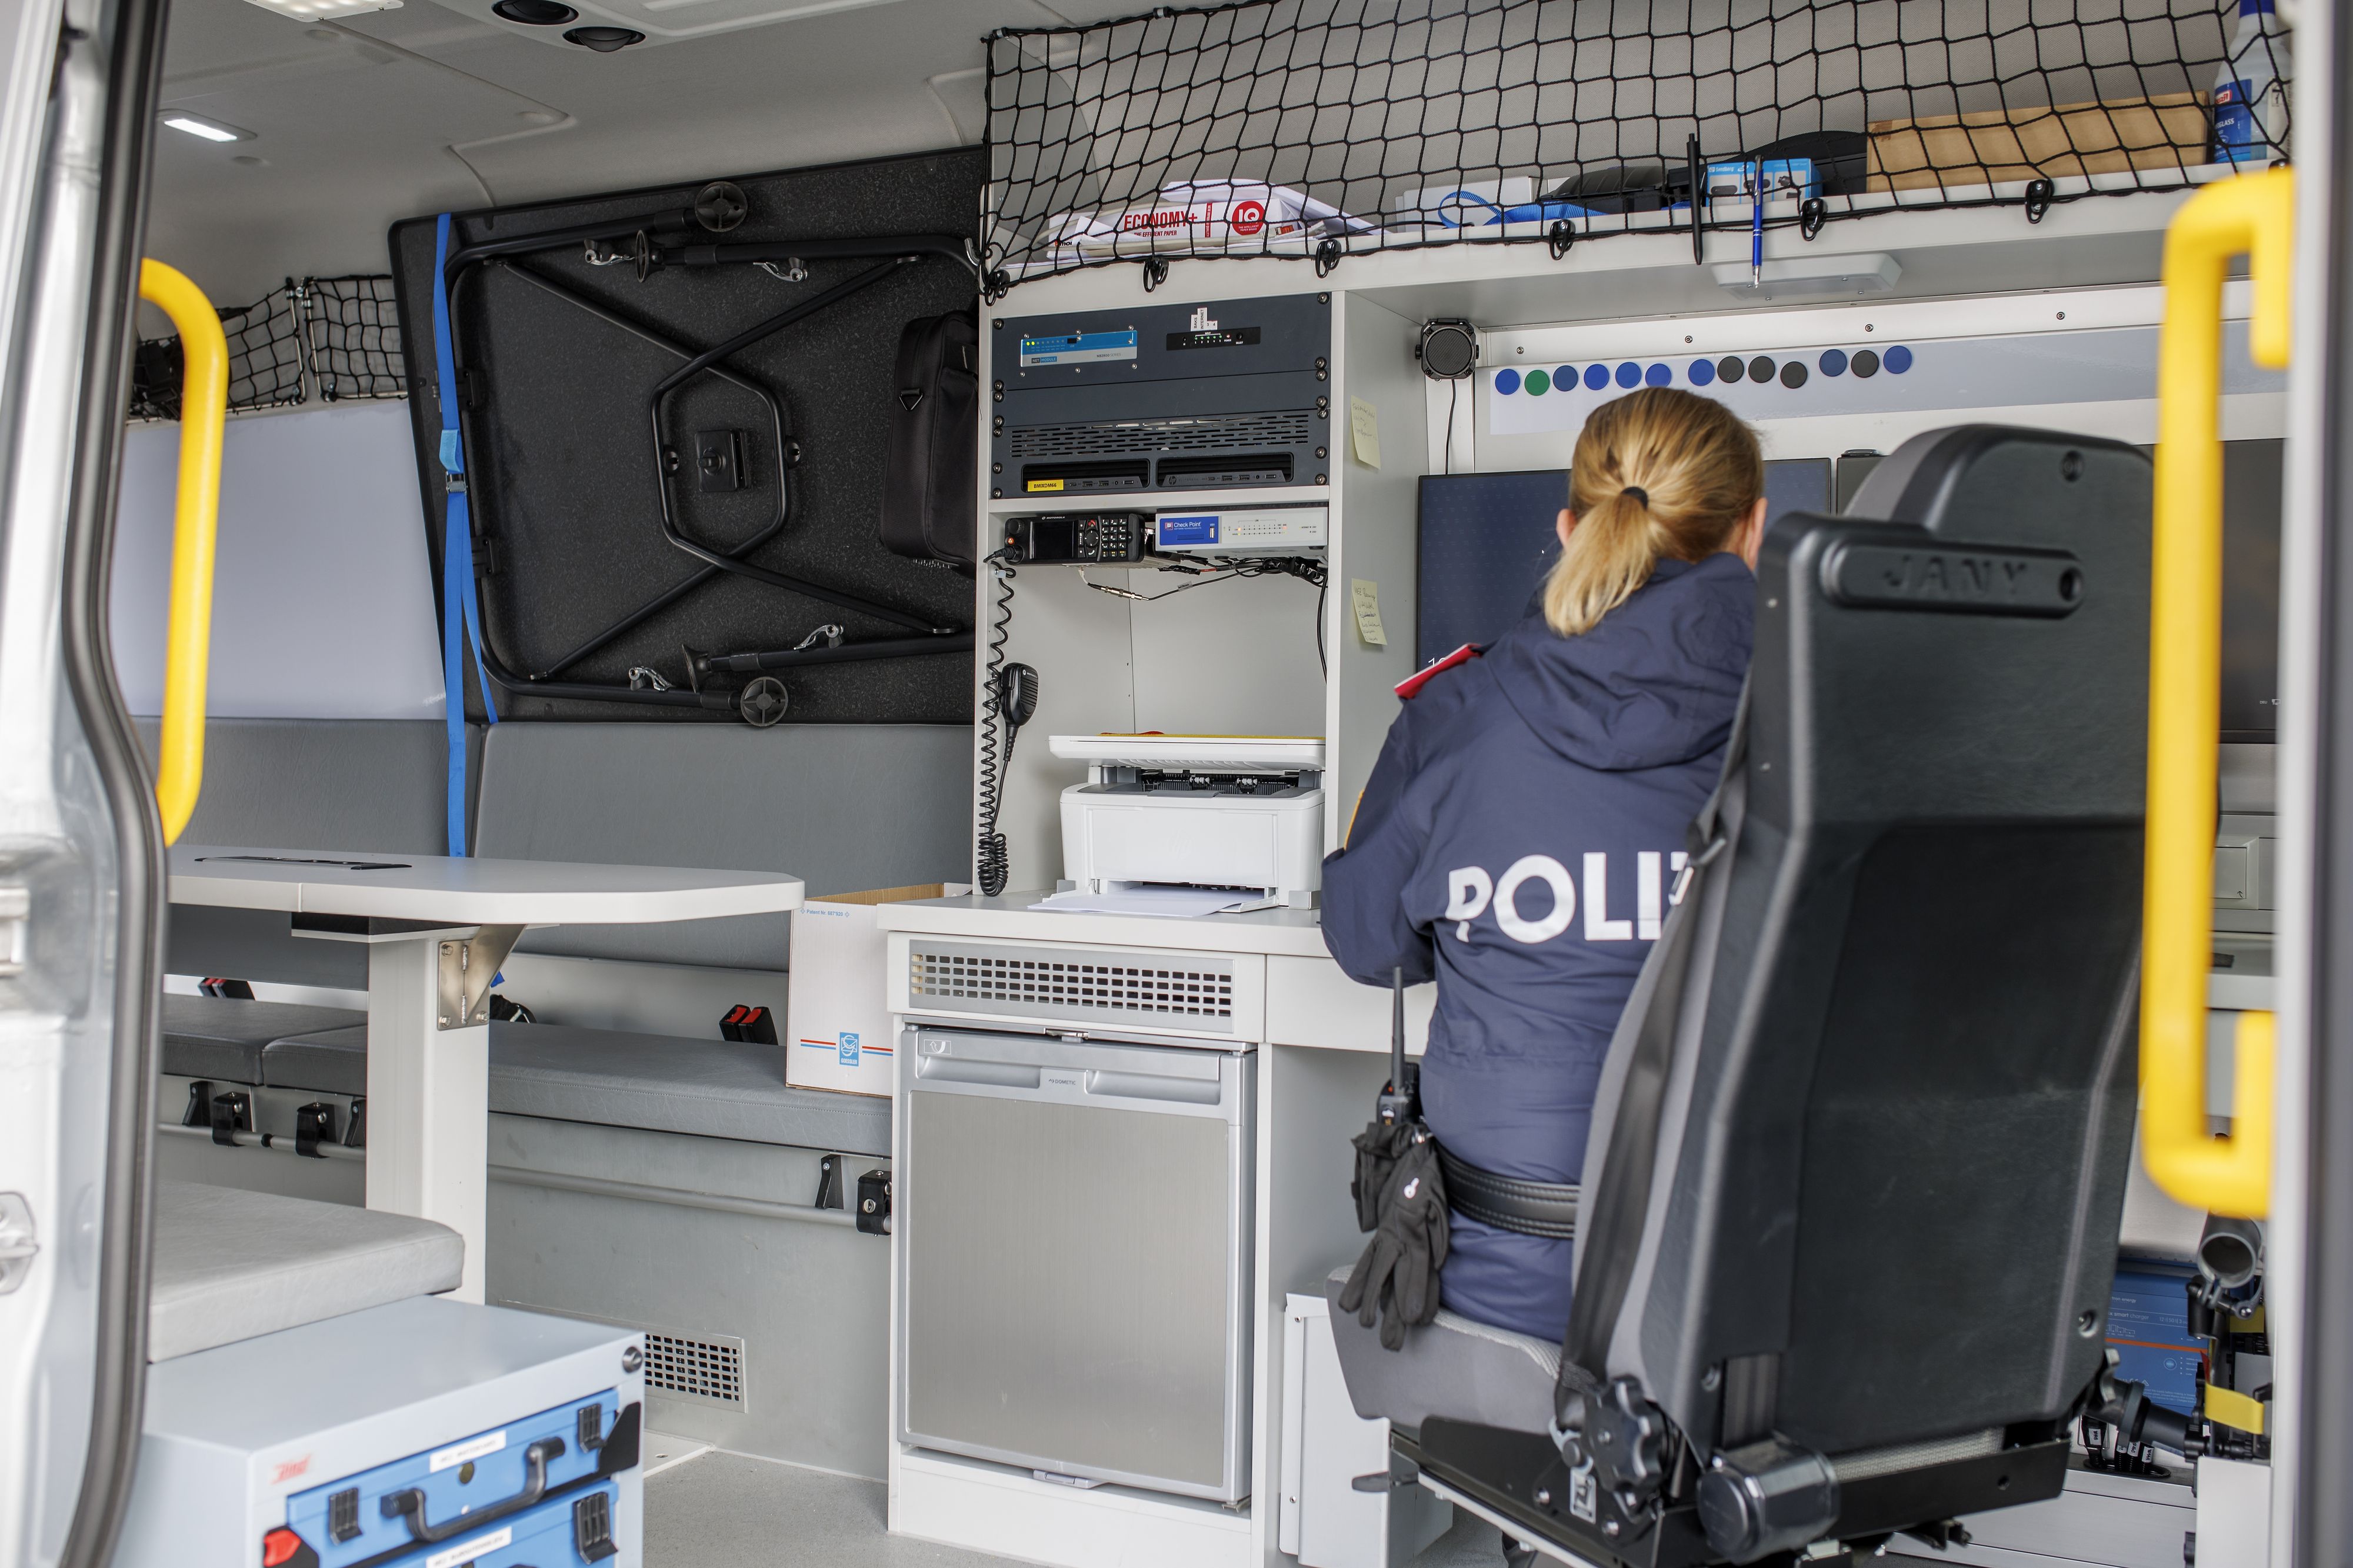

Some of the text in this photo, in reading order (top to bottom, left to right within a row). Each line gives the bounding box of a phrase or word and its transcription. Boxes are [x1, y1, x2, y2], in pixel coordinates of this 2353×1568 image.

[1124, 211, 1198, 231] ECONOMY+
[1238, 208, 1259, 225] IQ
[1884, 554, 2027, 595] JANY
